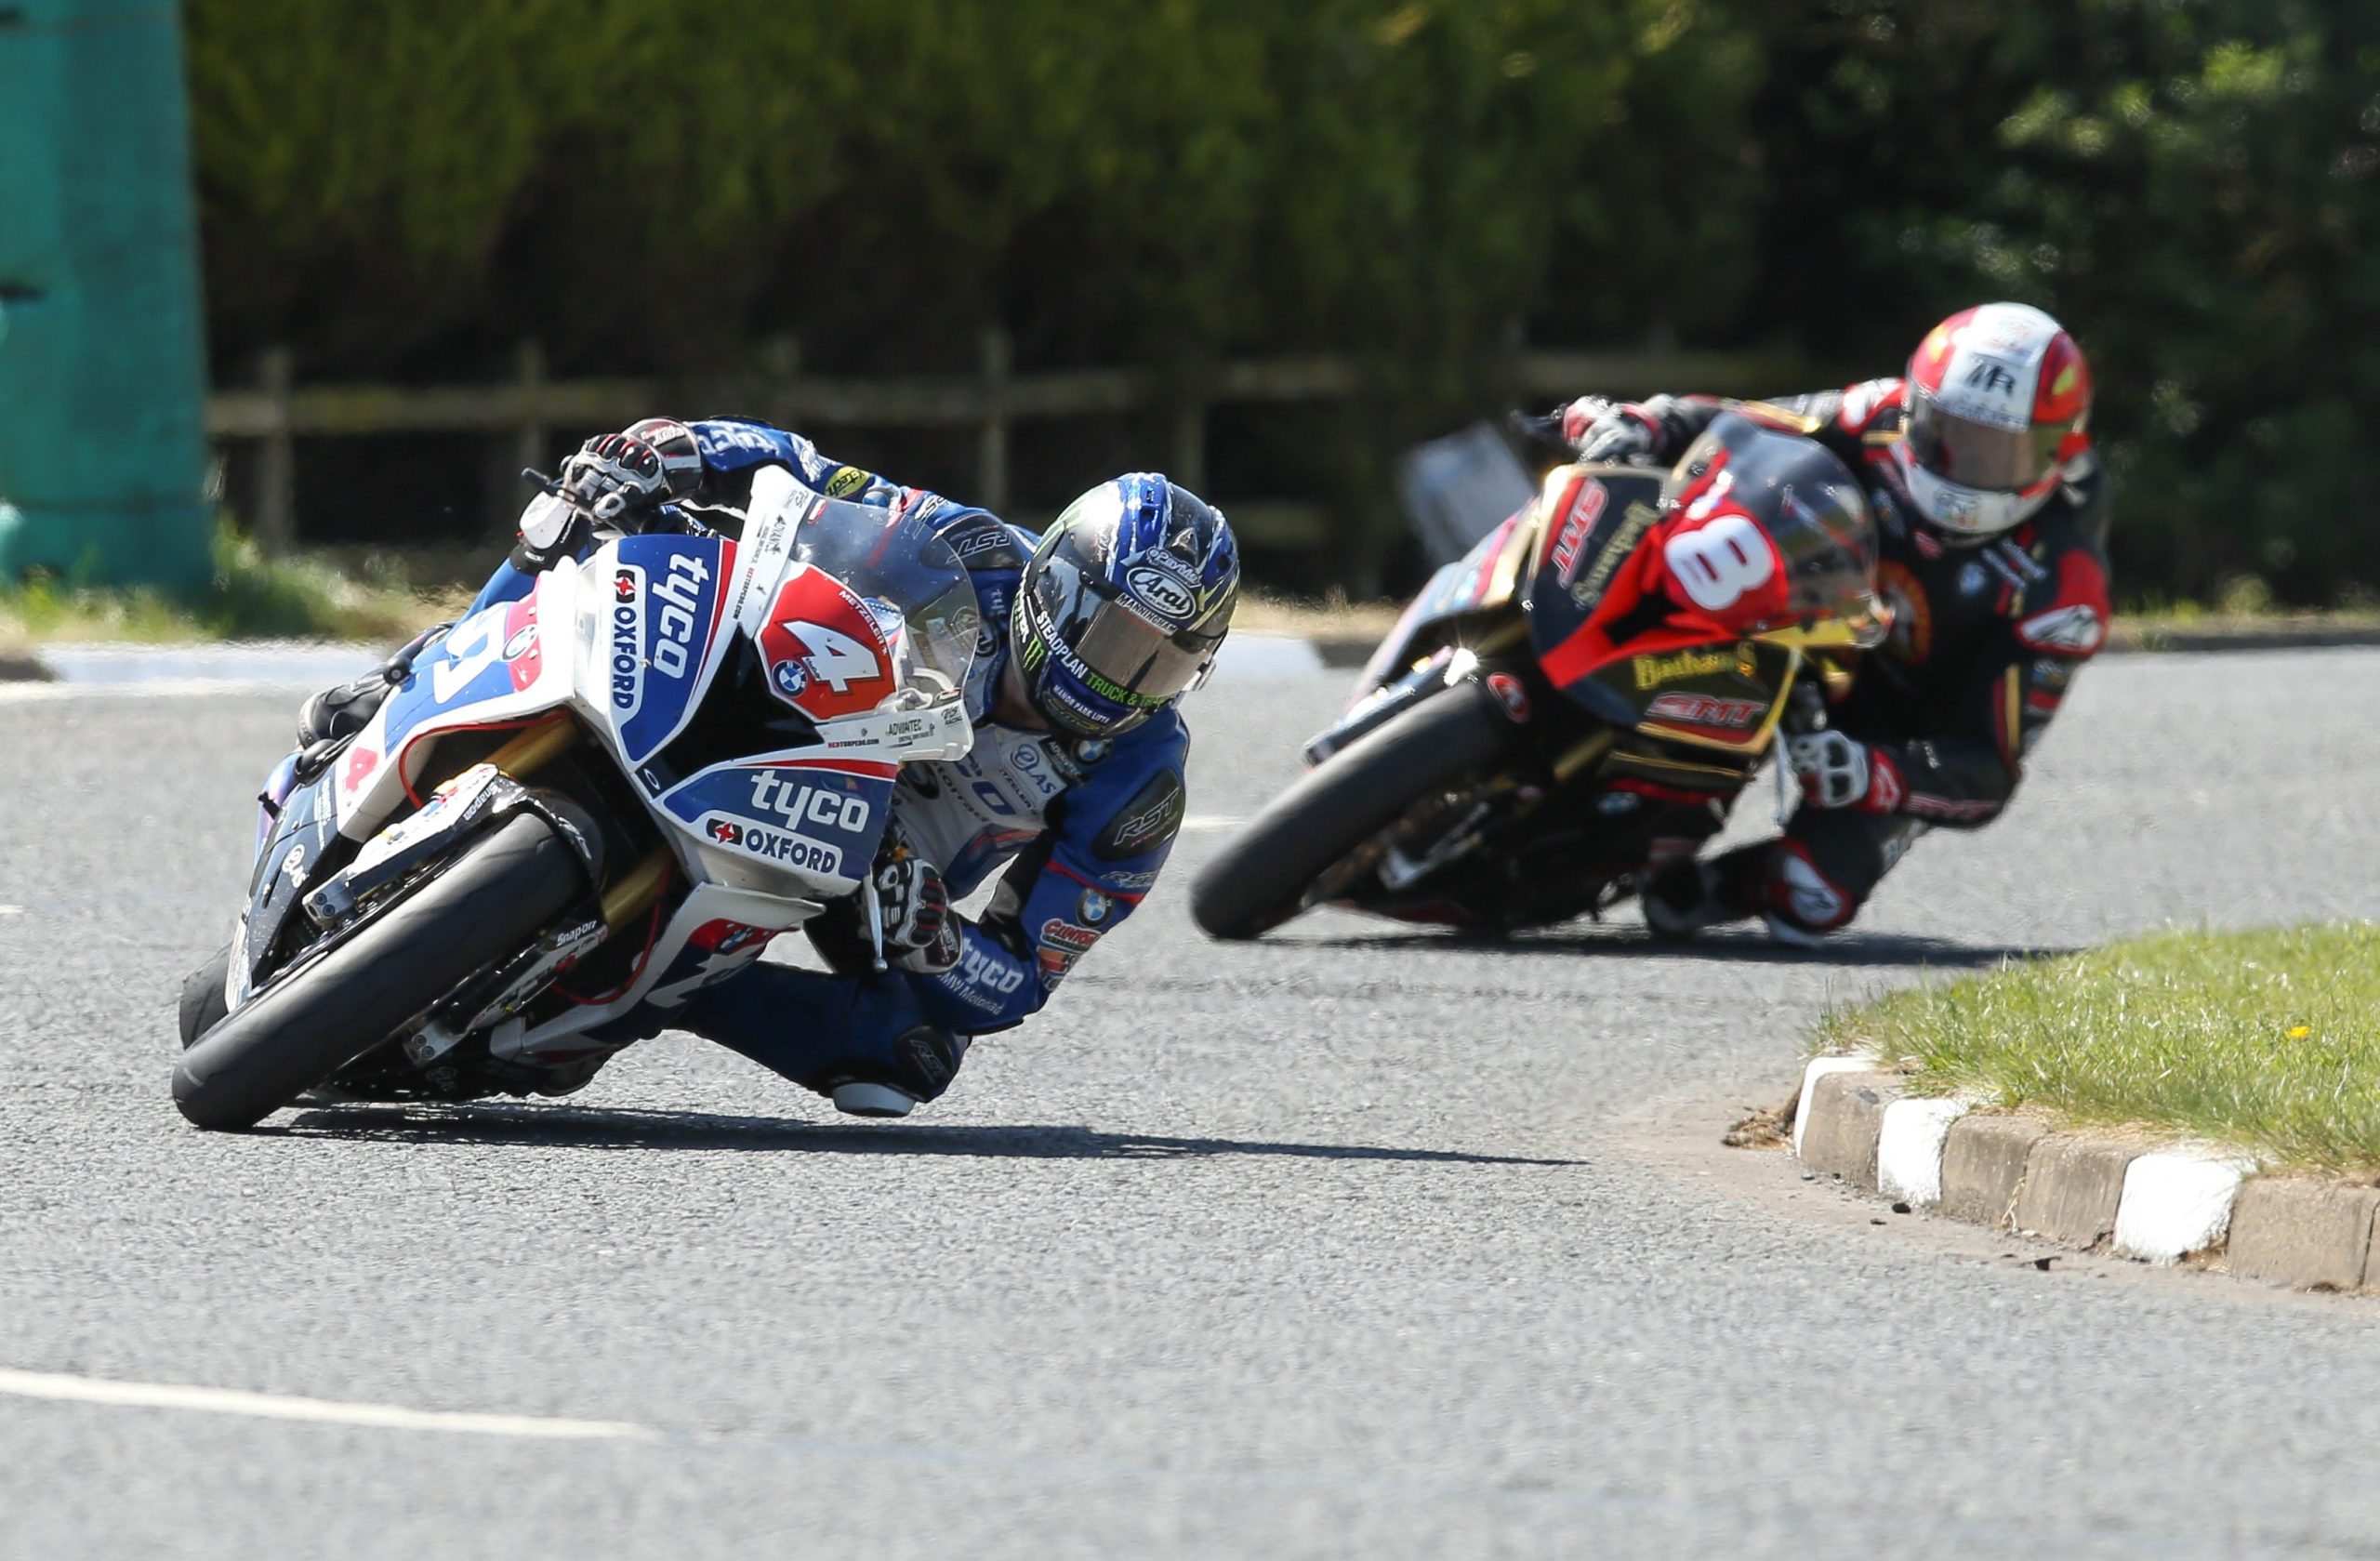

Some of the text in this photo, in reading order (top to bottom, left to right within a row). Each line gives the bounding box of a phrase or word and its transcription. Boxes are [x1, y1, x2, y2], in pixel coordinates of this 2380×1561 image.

[945, 531, 1012, 565] RST
[1664, 516, 1776, 611] 8
[652, 552, 709, 680] tyco
[839, 590, 885, 645] METZELER
[1136, 575, 1189, 611] Arai
[614, 611, 636, 710] OXFORD
[782, 620, 880, 693] 4
[1036, 610, 1088, 679] STEADPLAN
[1086, 671, 1128, 703] TRUCK
[1128, 692, 1138, 707] &
[1052, 684, 1073, 706] MANOR
[1073, 700, 1092, 718] PARK
[1645, 693, 1765, 725] SMT
[750, 770, 870, 833] tyco
[1114, 787, 1181, 846] RST
[745, 828, 837, 874] OXFORD
[960, 983, 1005, 1016] Motorrad
